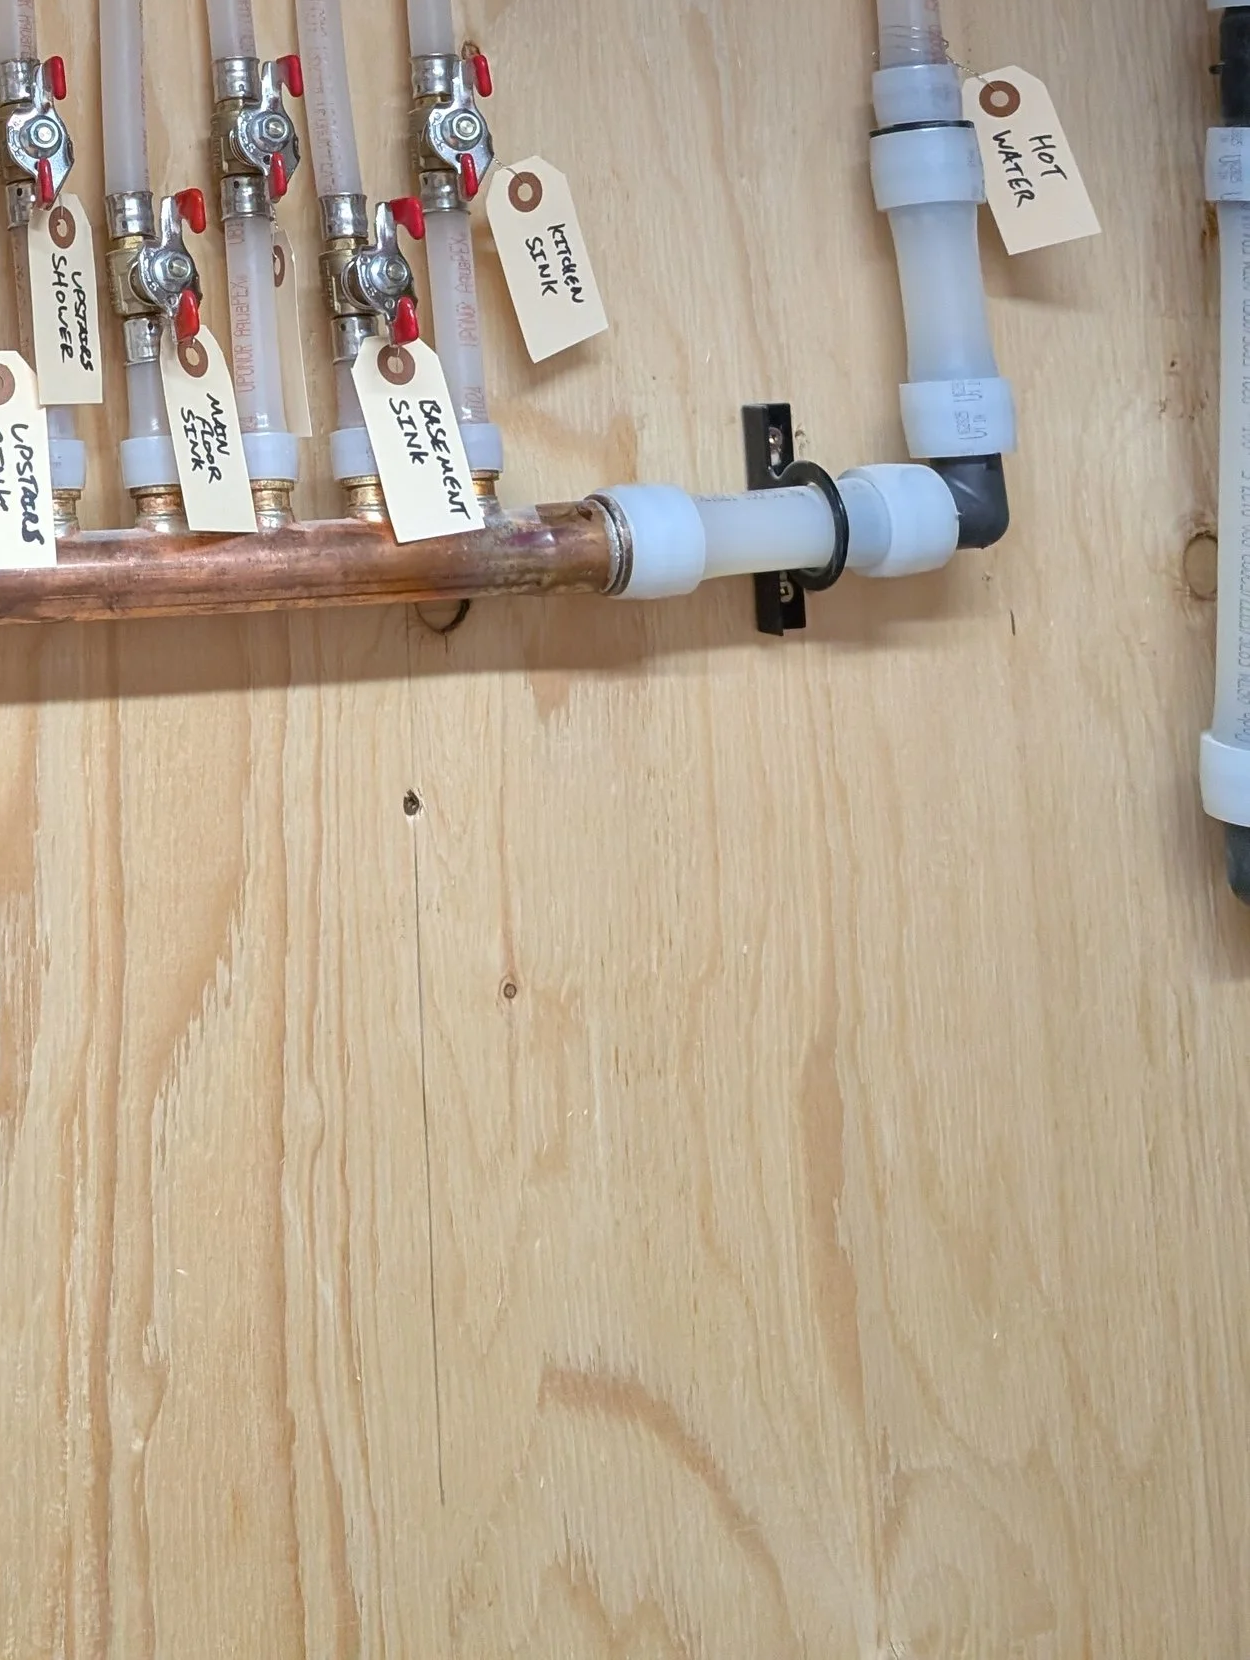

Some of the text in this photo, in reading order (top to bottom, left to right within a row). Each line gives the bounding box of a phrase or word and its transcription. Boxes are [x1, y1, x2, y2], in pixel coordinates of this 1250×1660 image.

[993, 129, 1035, 208] WATER
[1029, 135, 1067, 180] HOT
[525, 236, 558, 296] SINK
[547, 223, 584, 303] KITCHEN
[52, 253, 74, 363] SHOWER
[181, 407, 205, 472] SINK
[195, 415, 222, 484] FLOOR
[206, 393, 230, 455] MAIN
[389, 398, 429, 465] SINK
[418, 400, 471, 520] BASEMENT
